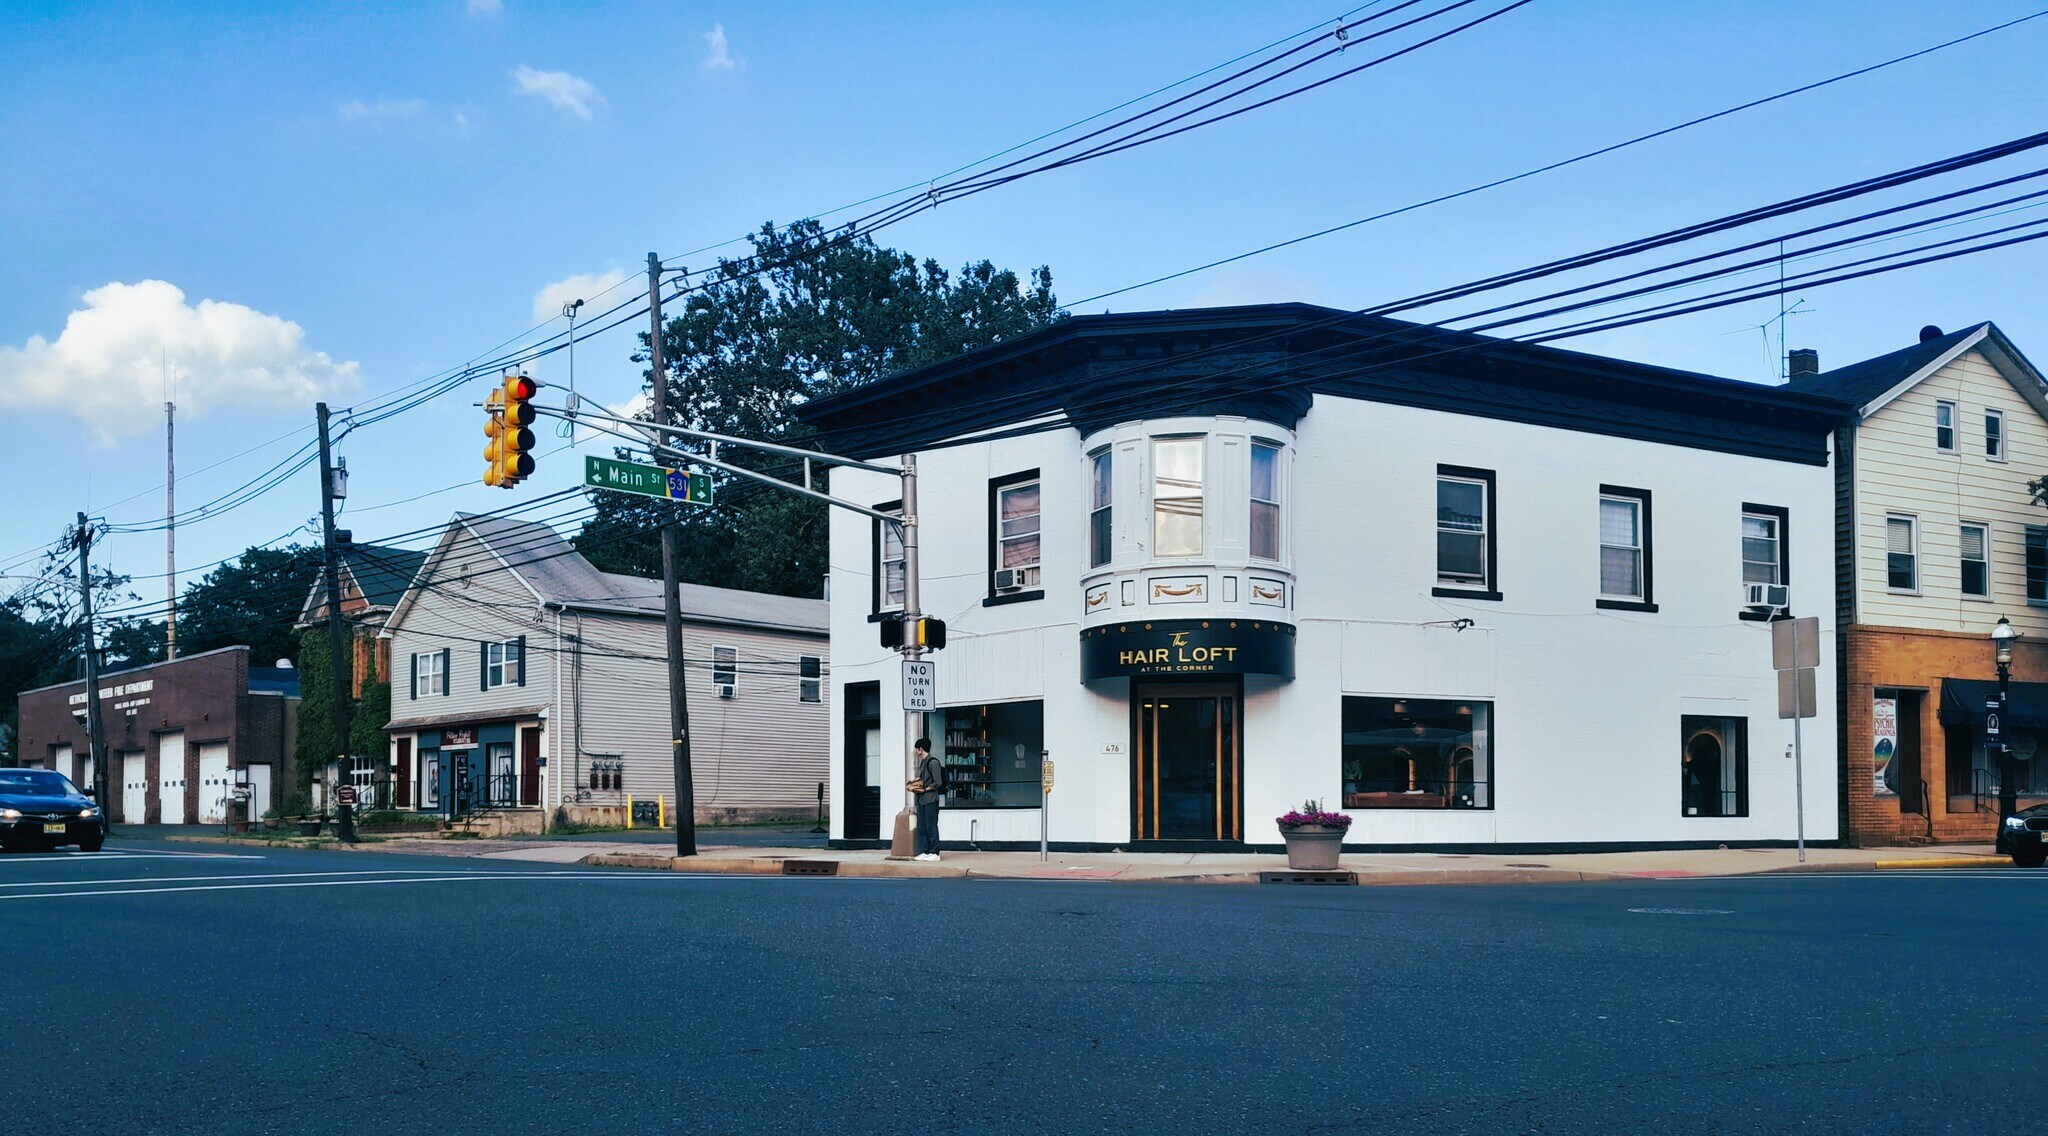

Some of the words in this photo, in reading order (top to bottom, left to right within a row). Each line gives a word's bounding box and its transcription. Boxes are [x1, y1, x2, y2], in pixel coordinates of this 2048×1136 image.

[593, 460, 600, 471] N
[609, 466, 643, 487] Main
[651, 473, 661, 485] St
[669, 477, 687, 492] 531
[699, 477, 705, 488] S
[1168, 631, 1190, 647] The
[1120, 648, 1169, 665] HAIR
[1178, 647, 1238, 662] LOFT
[911, 665, 927, 675] NO
[908, 677, 930, 686] TURN
[114, 685, 125, 697] FIRE
[913, 688, 925, 696] ON
[911, 698, 927, 707] RED
[1105, 744, 1120, 752] 476
